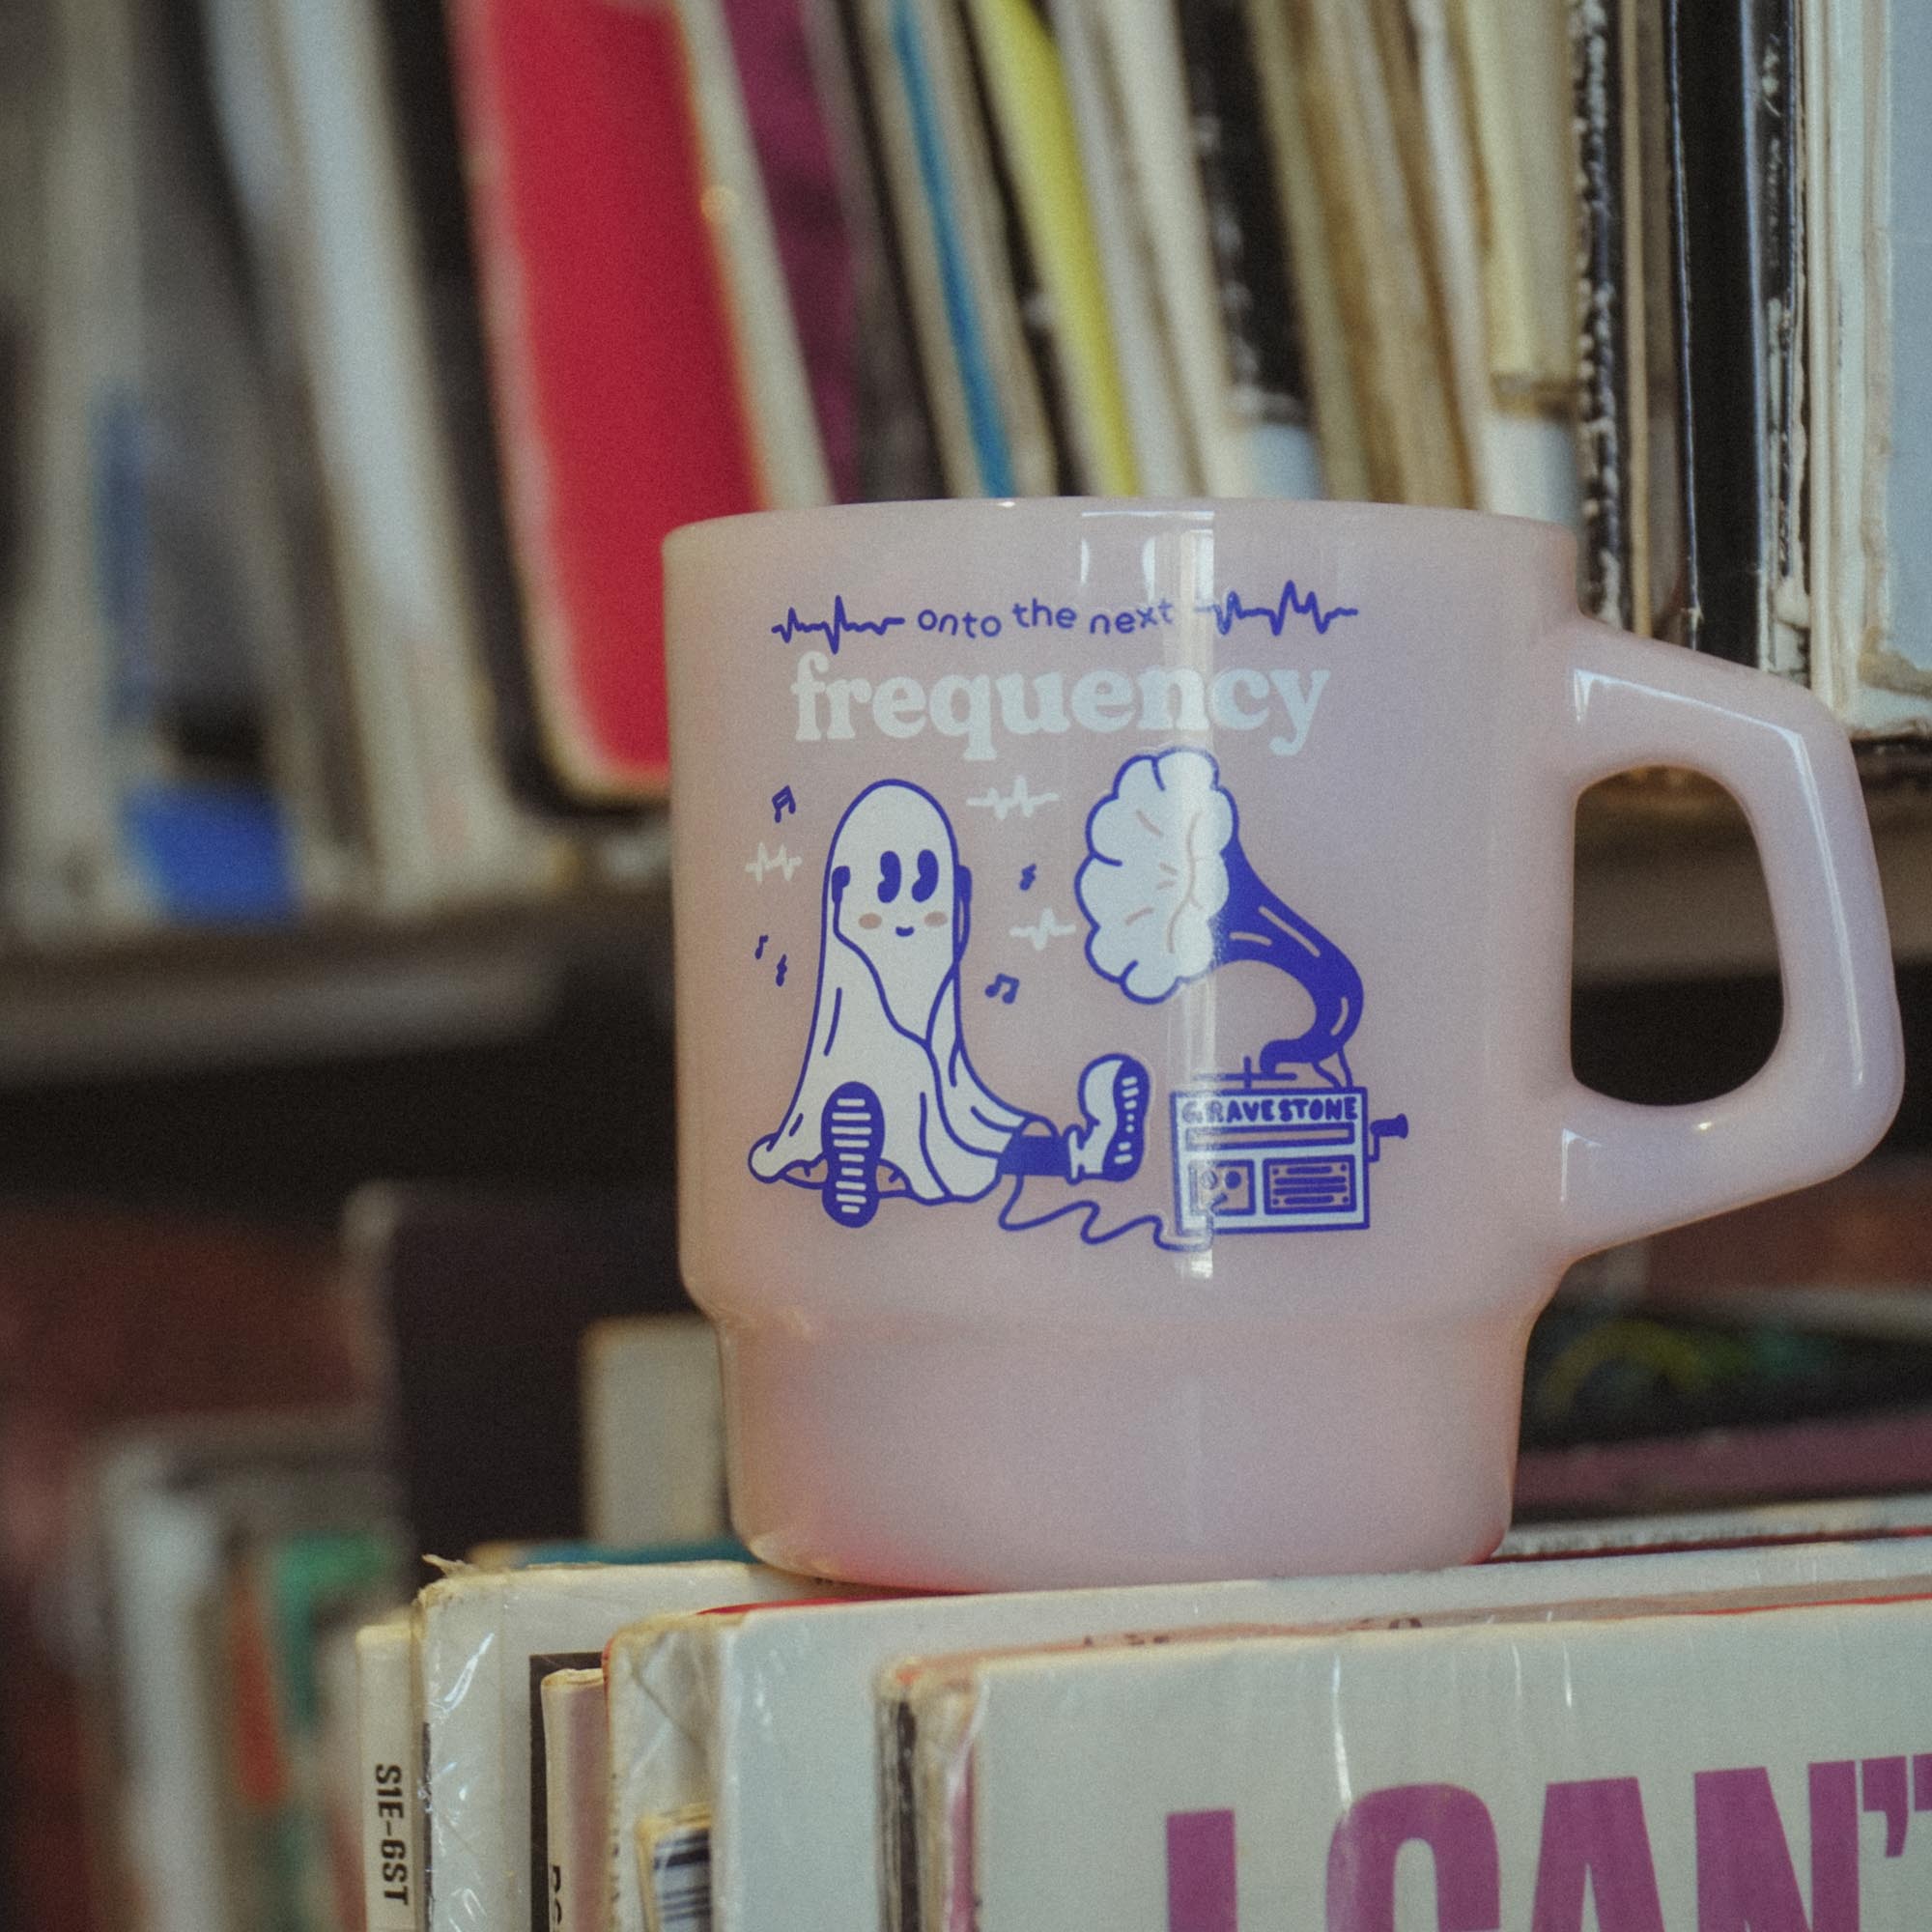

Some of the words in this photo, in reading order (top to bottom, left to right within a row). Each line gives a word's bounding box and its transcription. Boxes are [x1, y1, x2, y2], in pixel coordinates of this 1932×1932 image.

[918, 608, 1002, 639] onto
[1012, 597, 1077, 629] the
[1090, 597, 1174, 635] next
[789, 651, 1332, 760] frequency
[1181, 1095, 1358, 1123] GRAVESTONE
